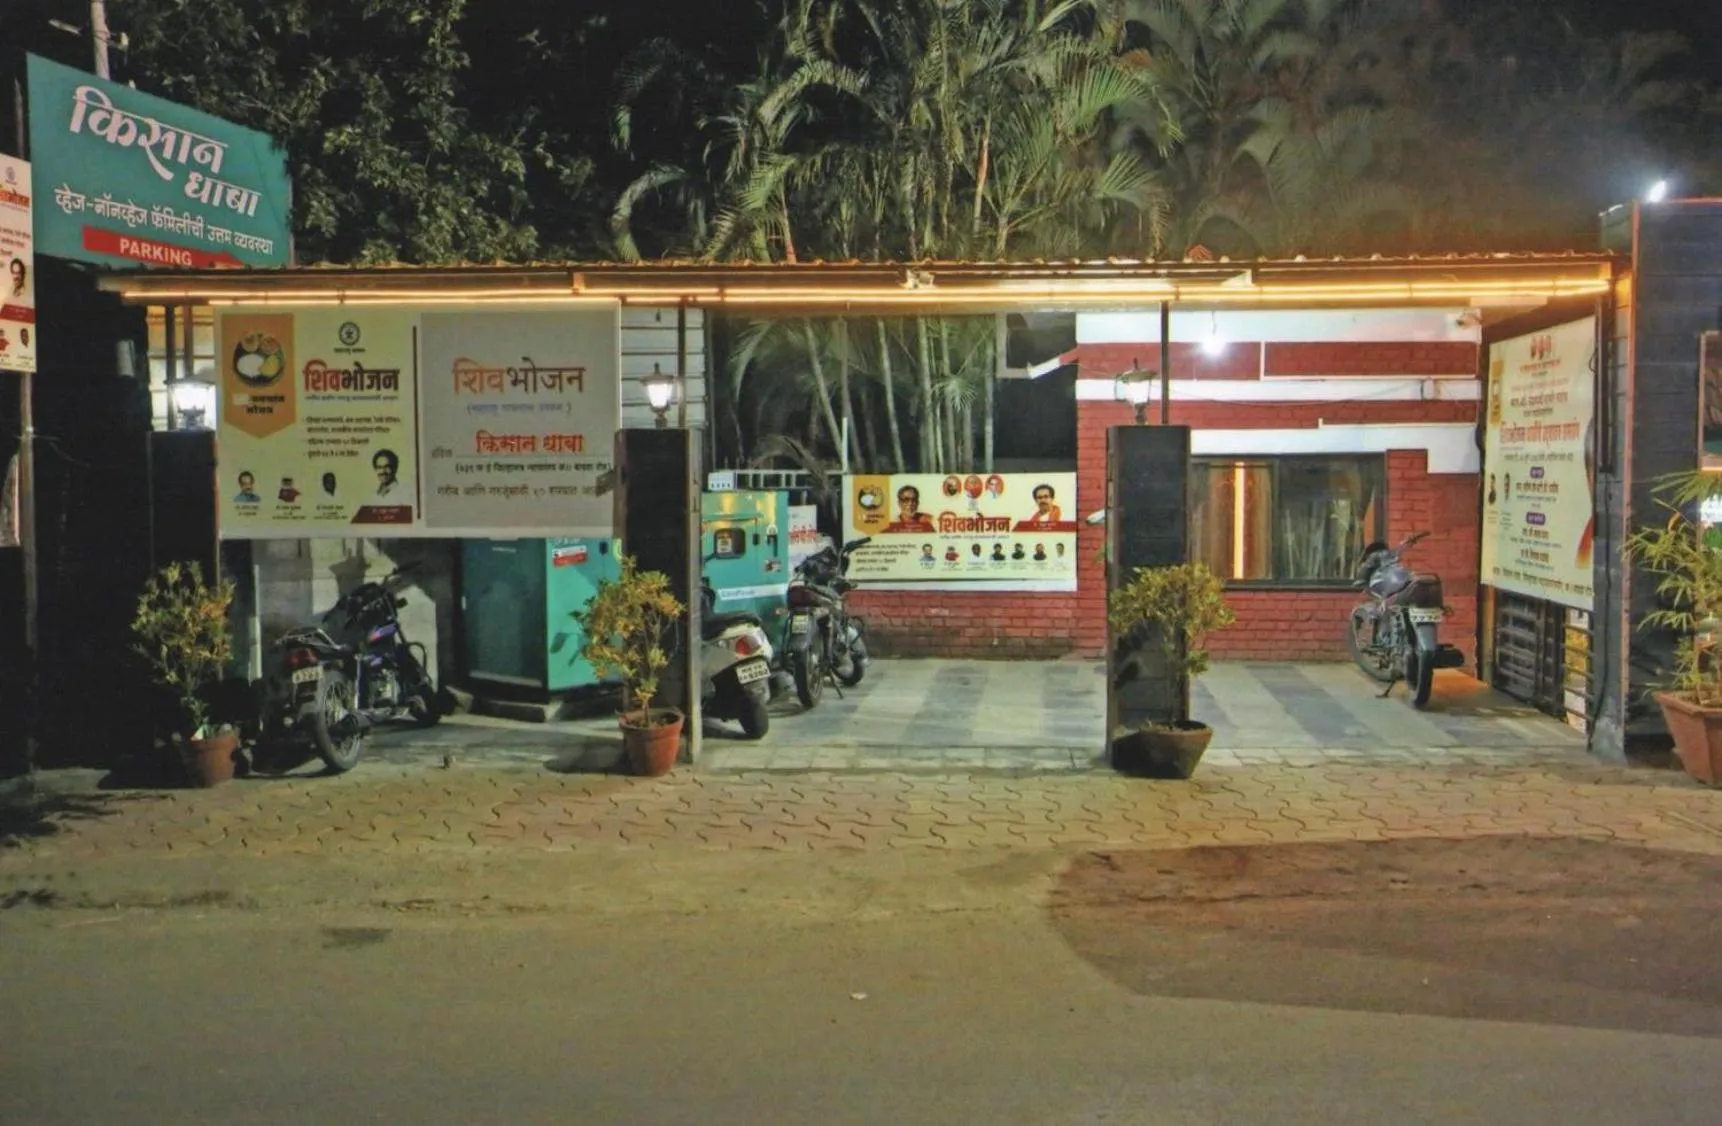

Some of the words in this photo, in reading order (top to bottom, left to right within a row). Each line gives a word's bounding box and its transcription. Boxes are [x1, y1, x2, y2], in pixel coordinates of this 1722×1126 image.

[69, 85, 228, 181] किसान
[184, 170, 262, 217] धाबा
[151, 204, 204, 240] फॅमिलीची
[207, 225, 231, 245] उत्तम
[119, 238, 193, 266] PARKING
[302, 359, 400, 392] शिवभोजन
[452, 356, 587, 394] शिवभोजन
[937, 510, 1012, 534] शिवभोजन
